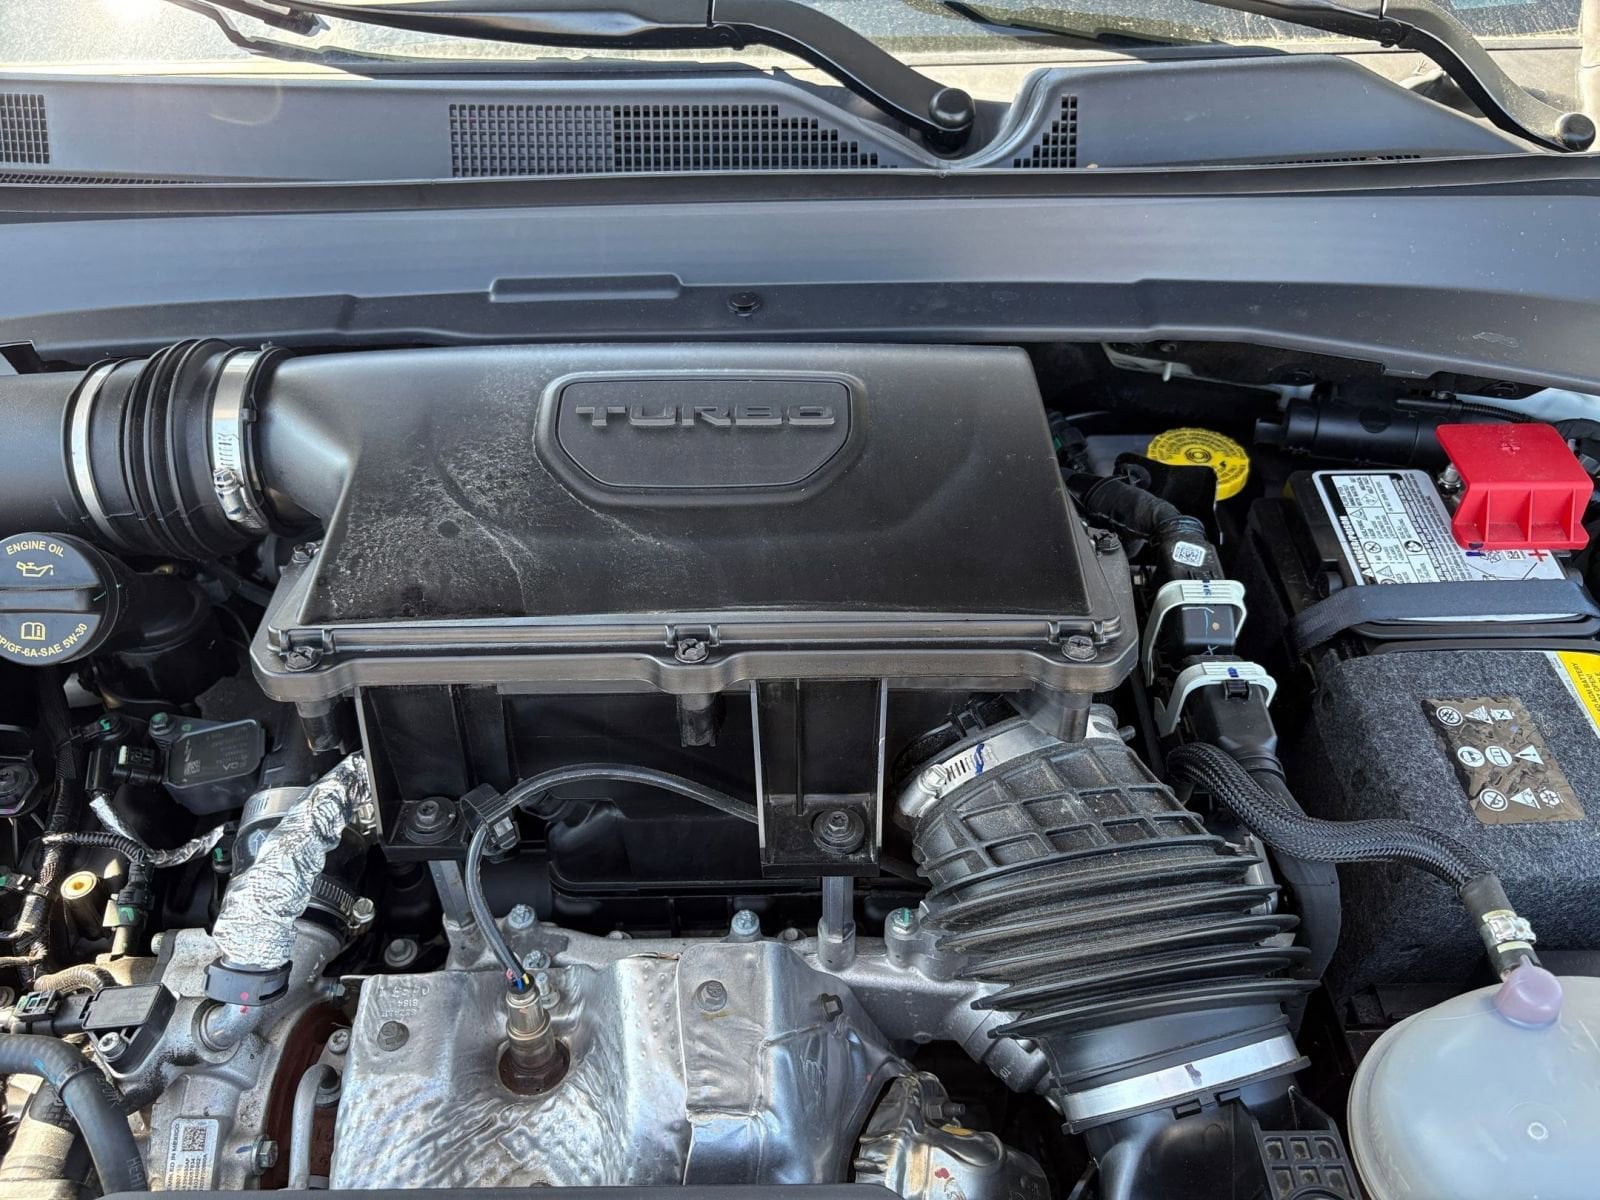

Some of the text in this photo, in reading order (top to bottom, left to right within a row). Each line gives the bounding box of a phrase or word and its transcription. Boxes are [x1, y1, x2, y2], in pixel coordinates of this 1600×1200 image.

[575, 404, 835, 427] TURBO
[6, 540, 65, 558] ENGINE OIL
[0, 623, 88, 658] P/GF-6A-SAE 5W-30
[1571, 662, 1591, 689] BATTERY
[172, 1123, 180, 1152] MEXICO
